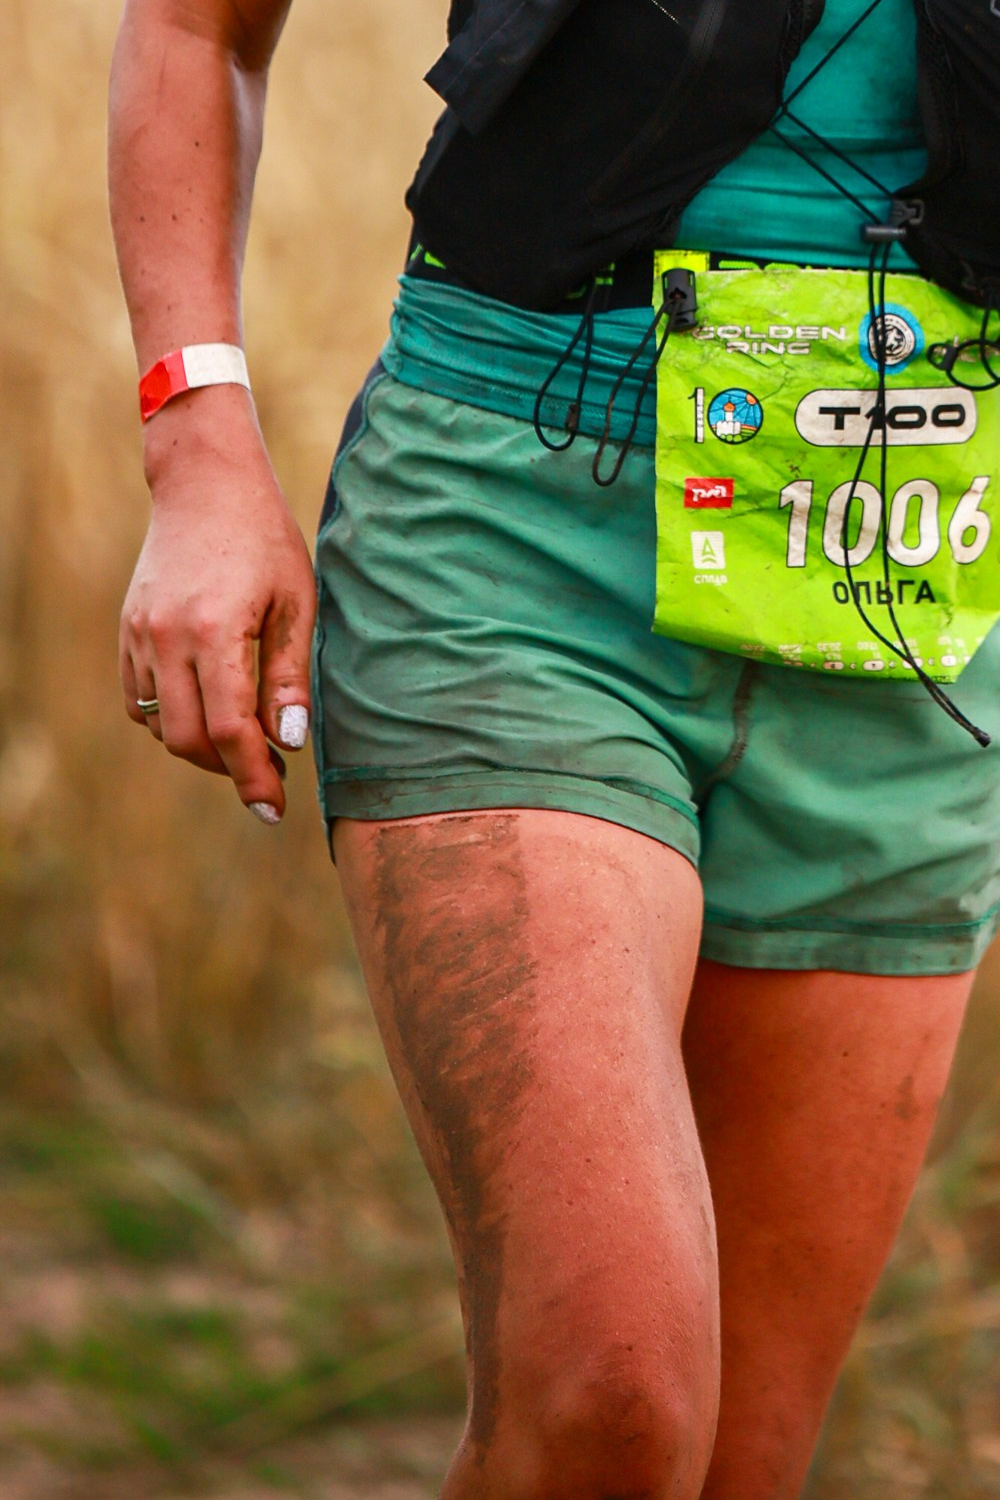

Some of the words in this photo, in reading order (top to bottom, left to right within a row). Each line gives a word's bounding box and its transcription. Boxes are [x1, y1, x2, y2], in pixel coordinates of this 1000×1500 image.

[692, 324, 846, 340] GOLDEN
[726, 341, 811, 355] RING
[818, 403, 966, 431] T100
[779, 475, 991, 567] 1006
